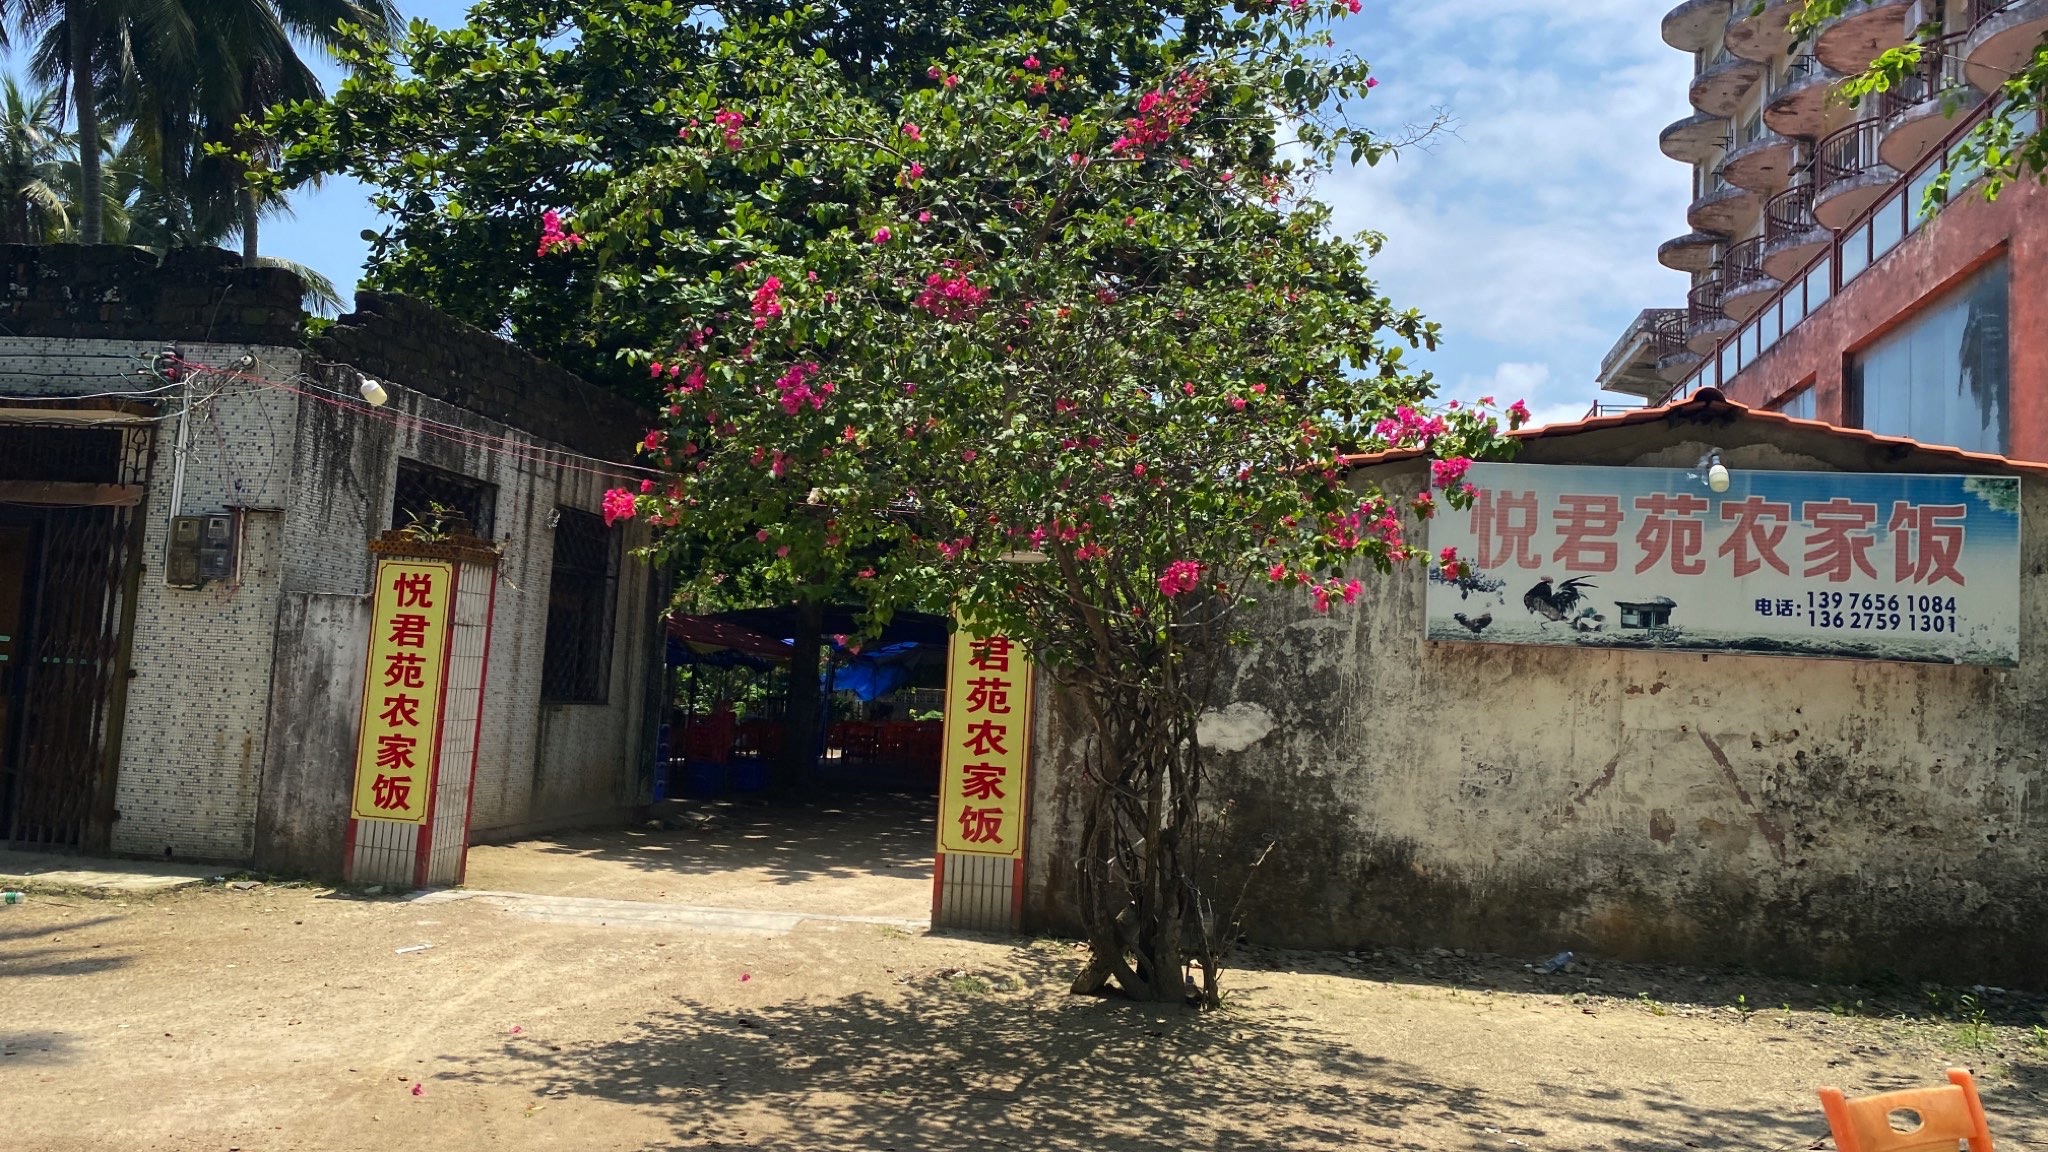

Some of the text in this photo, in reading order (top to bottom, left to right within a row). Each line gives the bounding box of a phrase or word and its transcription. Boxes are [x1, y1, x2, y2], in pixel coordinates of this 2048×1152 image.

[1469, 488, 1967, 587] 悦君苑农家饭
[371, 571, 433, 811] 悦君苑农家饭
[958, 636, 1014, 844] 君苑农家饭
